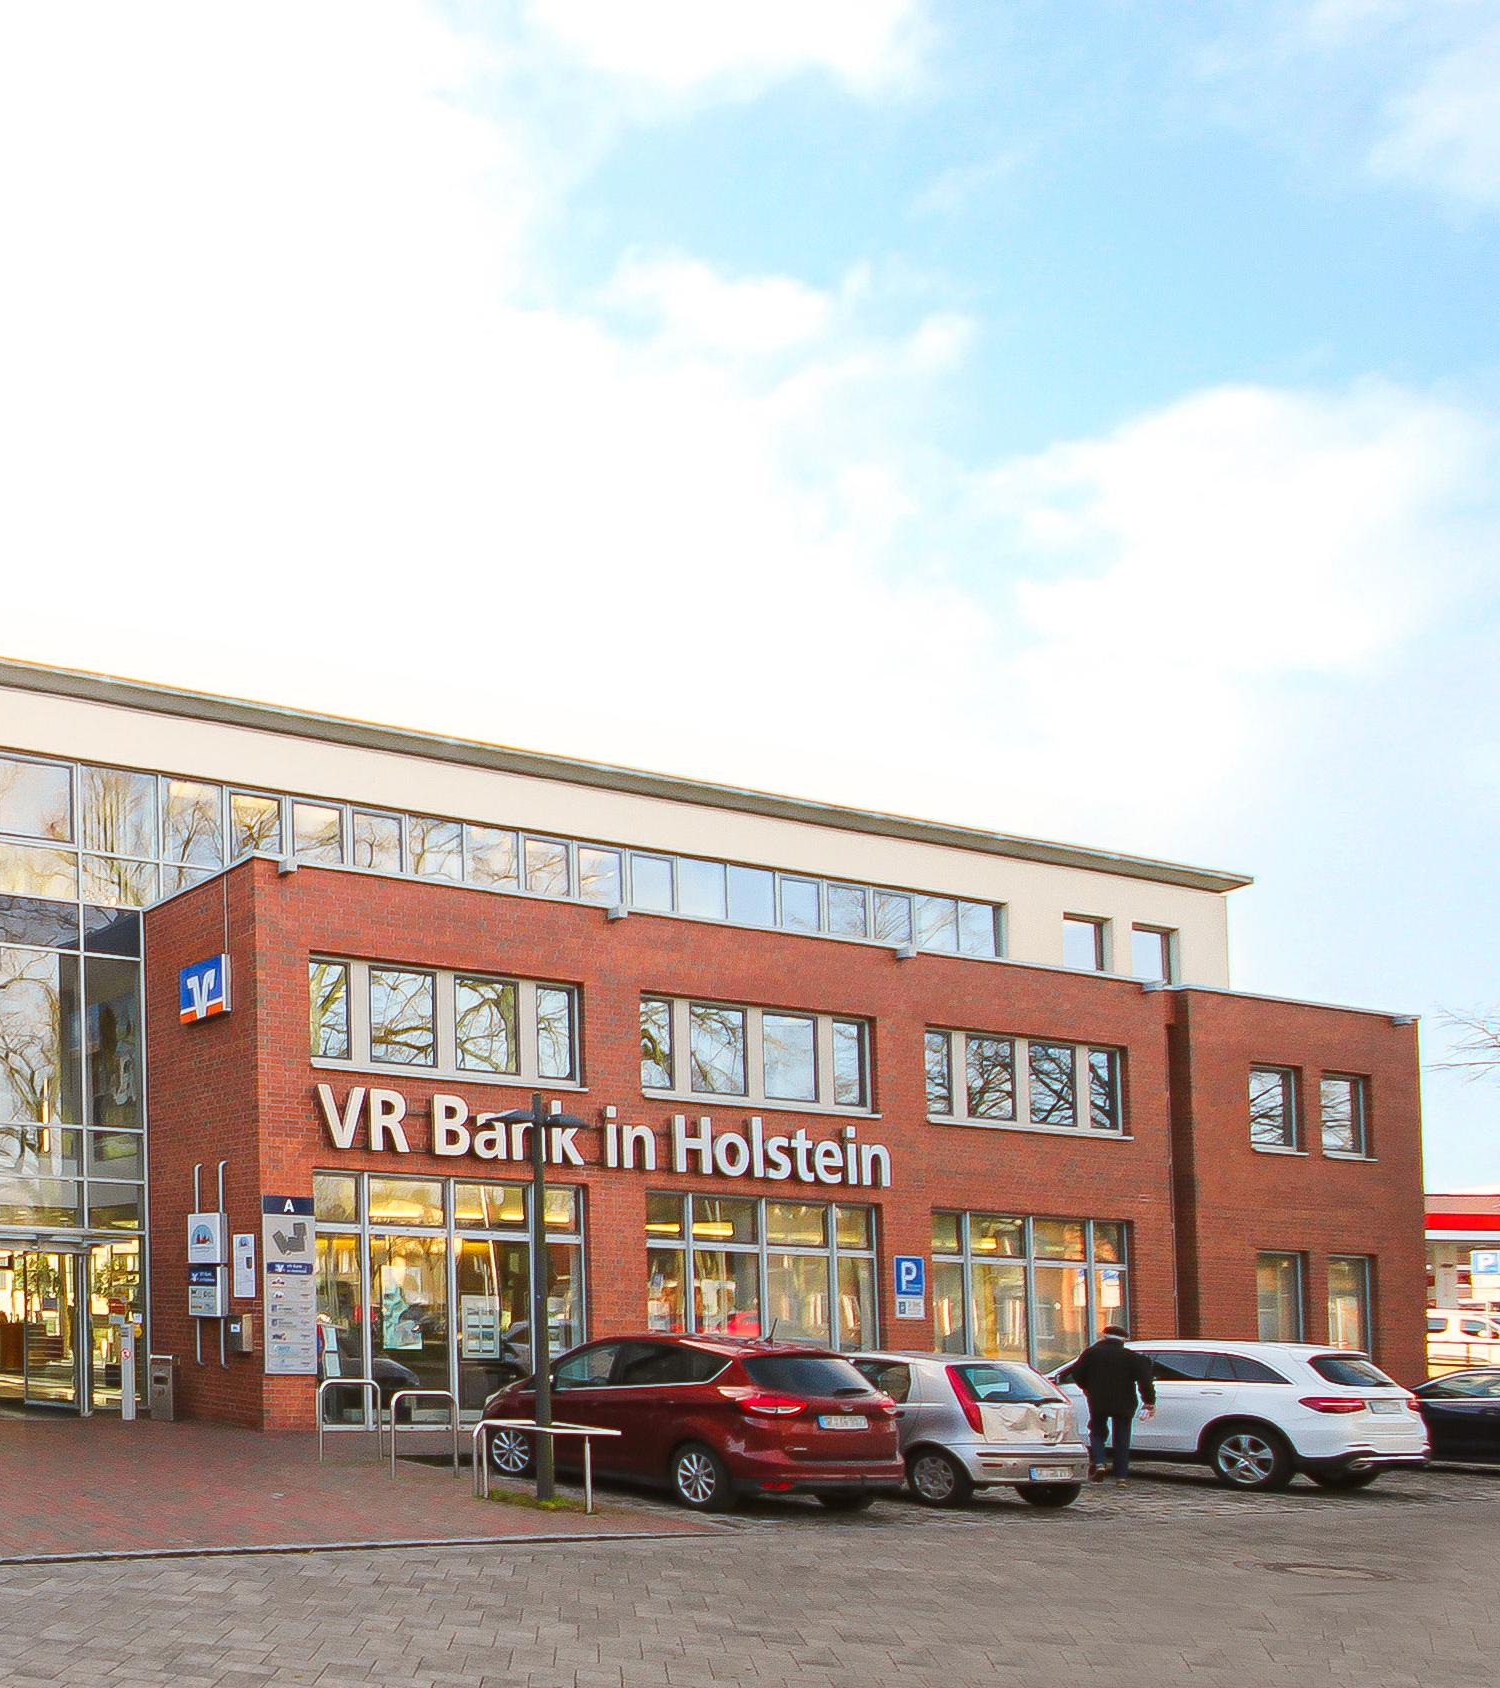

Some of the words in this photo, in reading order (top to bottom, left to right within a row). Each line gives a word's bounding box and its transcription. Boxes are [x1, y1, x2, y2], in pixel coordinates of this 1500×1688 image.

[316, 1083, 410, 1153] VR
[431, 1093, 585, 1166] Bank
[604, 1105, 656, 1171] in
[671, 1113, 891, 1187] Holstein
[283, 1198, 295, 1213] A
[900, 1261, 917, 1291] P
